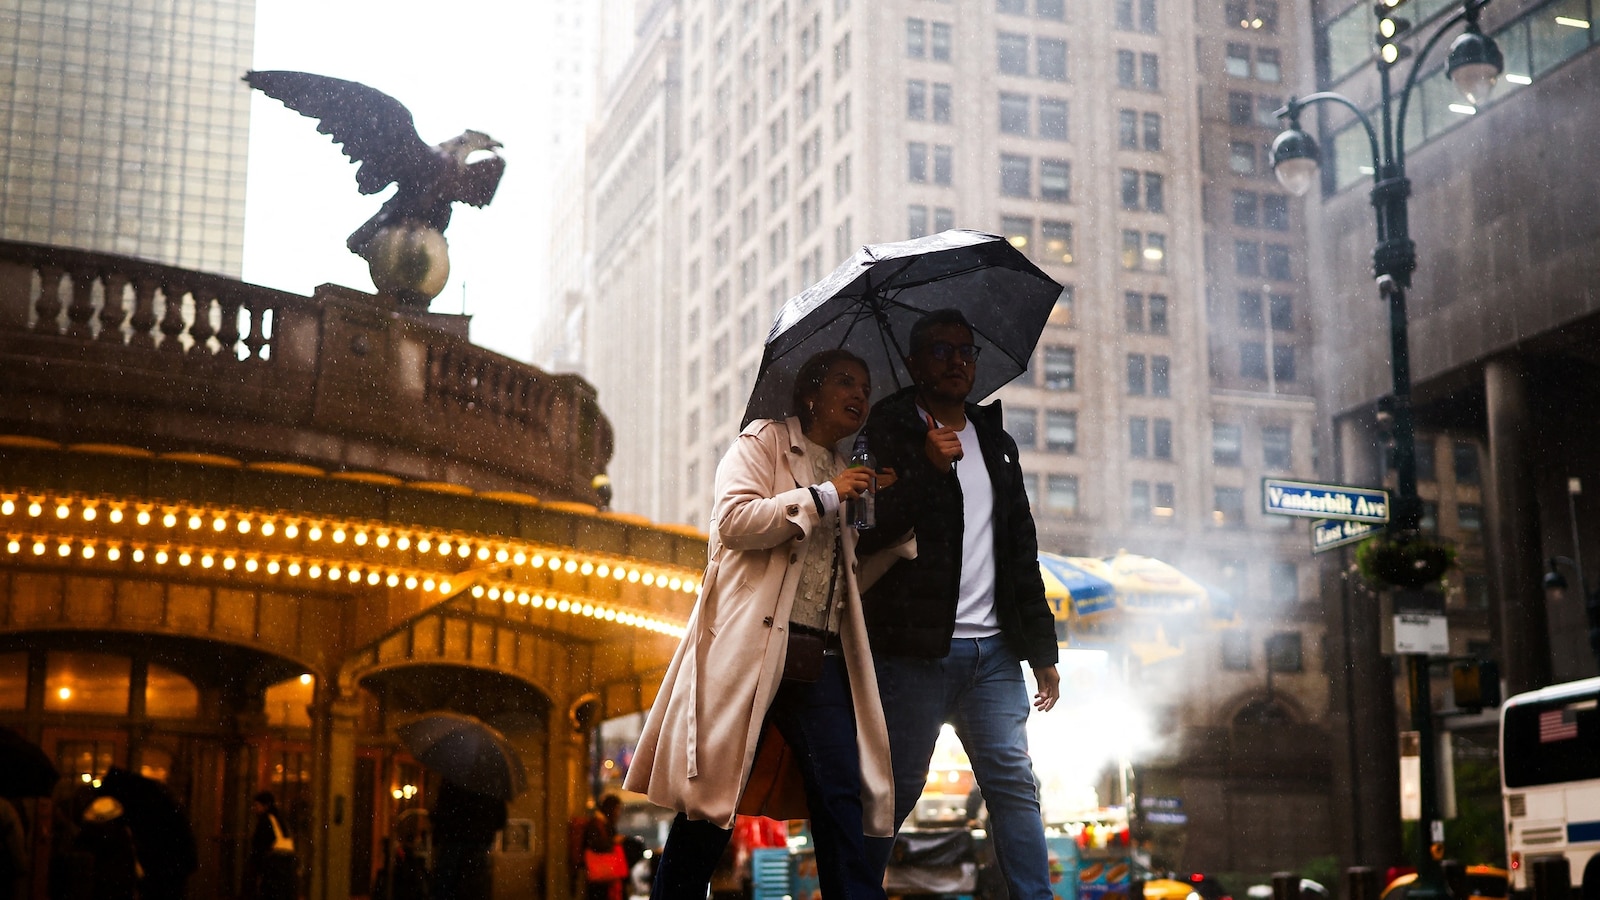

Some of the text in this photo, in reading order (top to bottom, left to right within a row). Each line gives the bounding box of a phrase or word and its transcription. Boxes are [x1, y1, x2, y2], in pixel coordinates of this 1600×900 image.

[1269, 487, 1385, 515] Vanderbilt Ave
[1316, 525, 1341, 544] East
